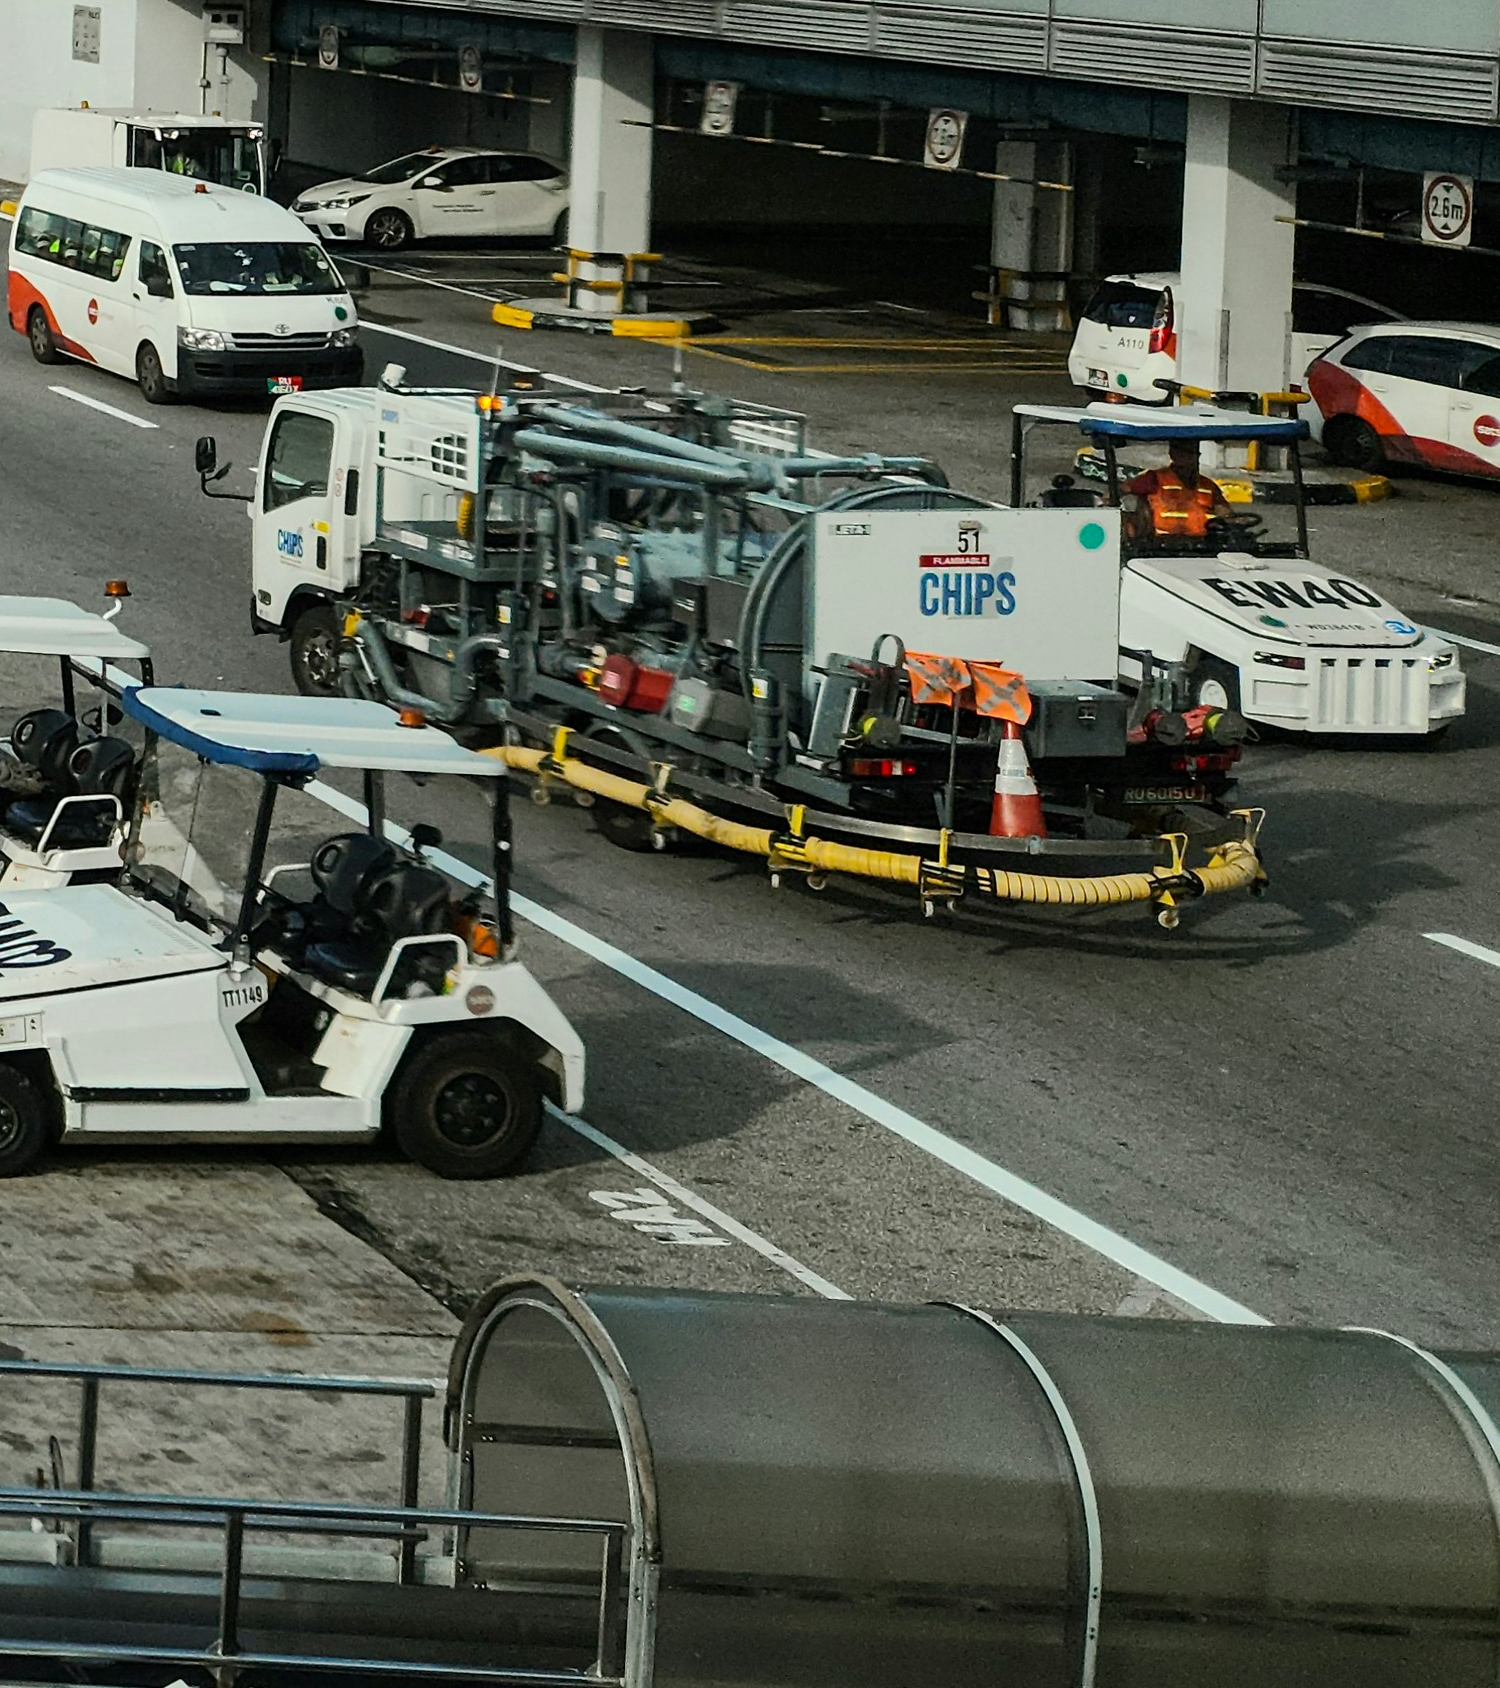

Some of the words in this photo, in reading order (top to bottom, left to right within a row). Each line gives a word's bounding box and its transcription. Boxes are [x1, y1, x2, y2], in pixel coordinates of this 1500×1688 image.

[1431, 196, 1463, 220] 2.6m
[1118, 337, 1144, 350] A110
[277, 529, 304, 558] CHIPS
[958, 530, 980, 553] 51
[933, 557, 988, 566] FLAMMABLE
[920, 572, 1016, 617] CHIPS
[1199, 578, 1382, 610] EW40
[222, 985, 263, 1009] TT1149
